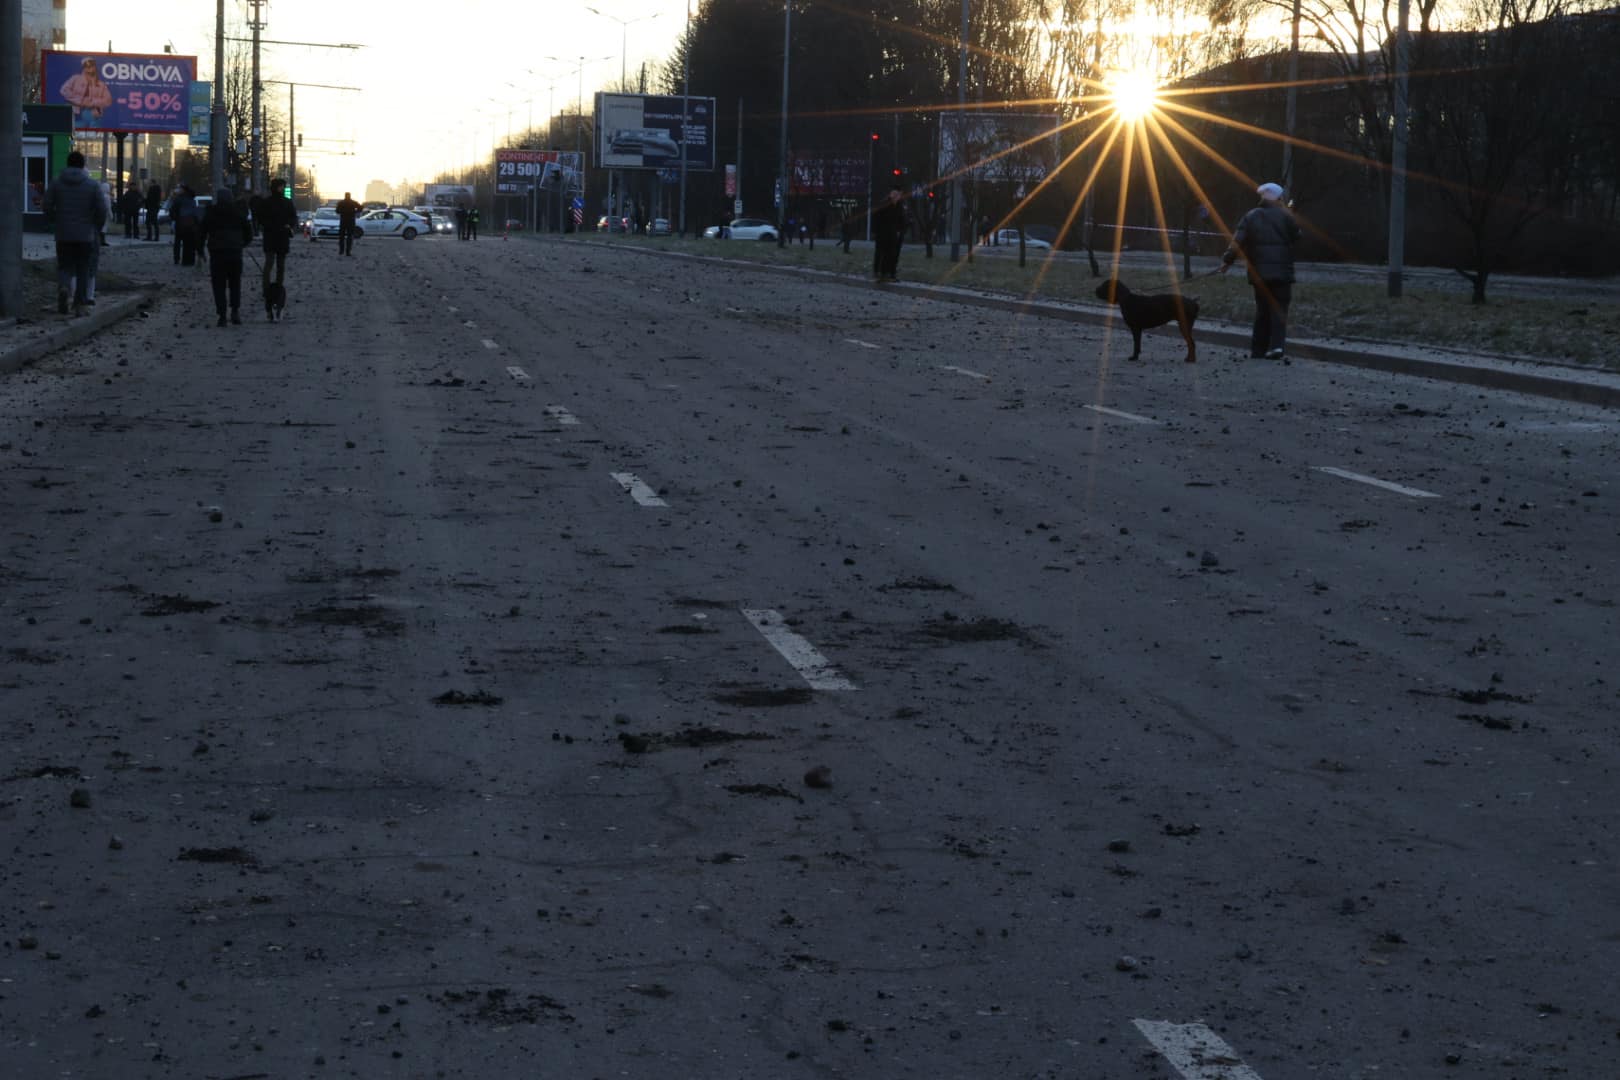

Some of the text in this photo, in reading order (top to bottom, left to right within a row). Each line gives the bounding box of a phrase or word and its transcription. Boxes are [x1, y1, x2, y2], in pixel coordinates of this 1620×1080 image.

[117, 91, 182, 112] -50%
[499, 161, 541, 176] 29 500
